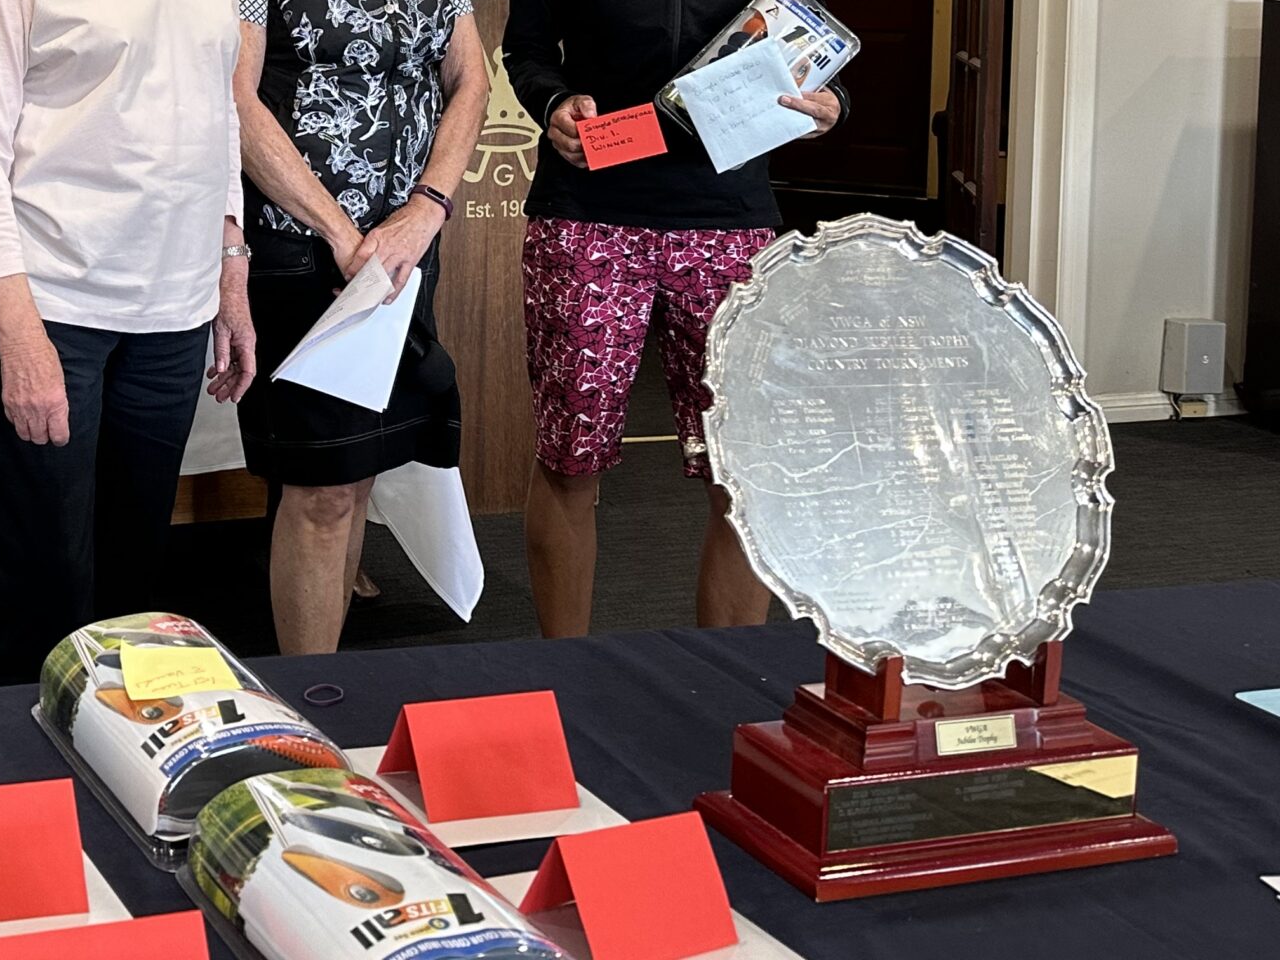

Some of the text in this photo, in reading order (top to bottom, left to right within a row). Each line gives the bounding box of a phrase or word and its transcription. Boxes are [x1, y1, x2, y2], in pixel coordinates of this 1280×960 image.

[465, 200, 495, 218] Est.
[807, 356, 969, 371] COUNTRY TOURNAMENTS
[407, 900, 449, 919] FITS
